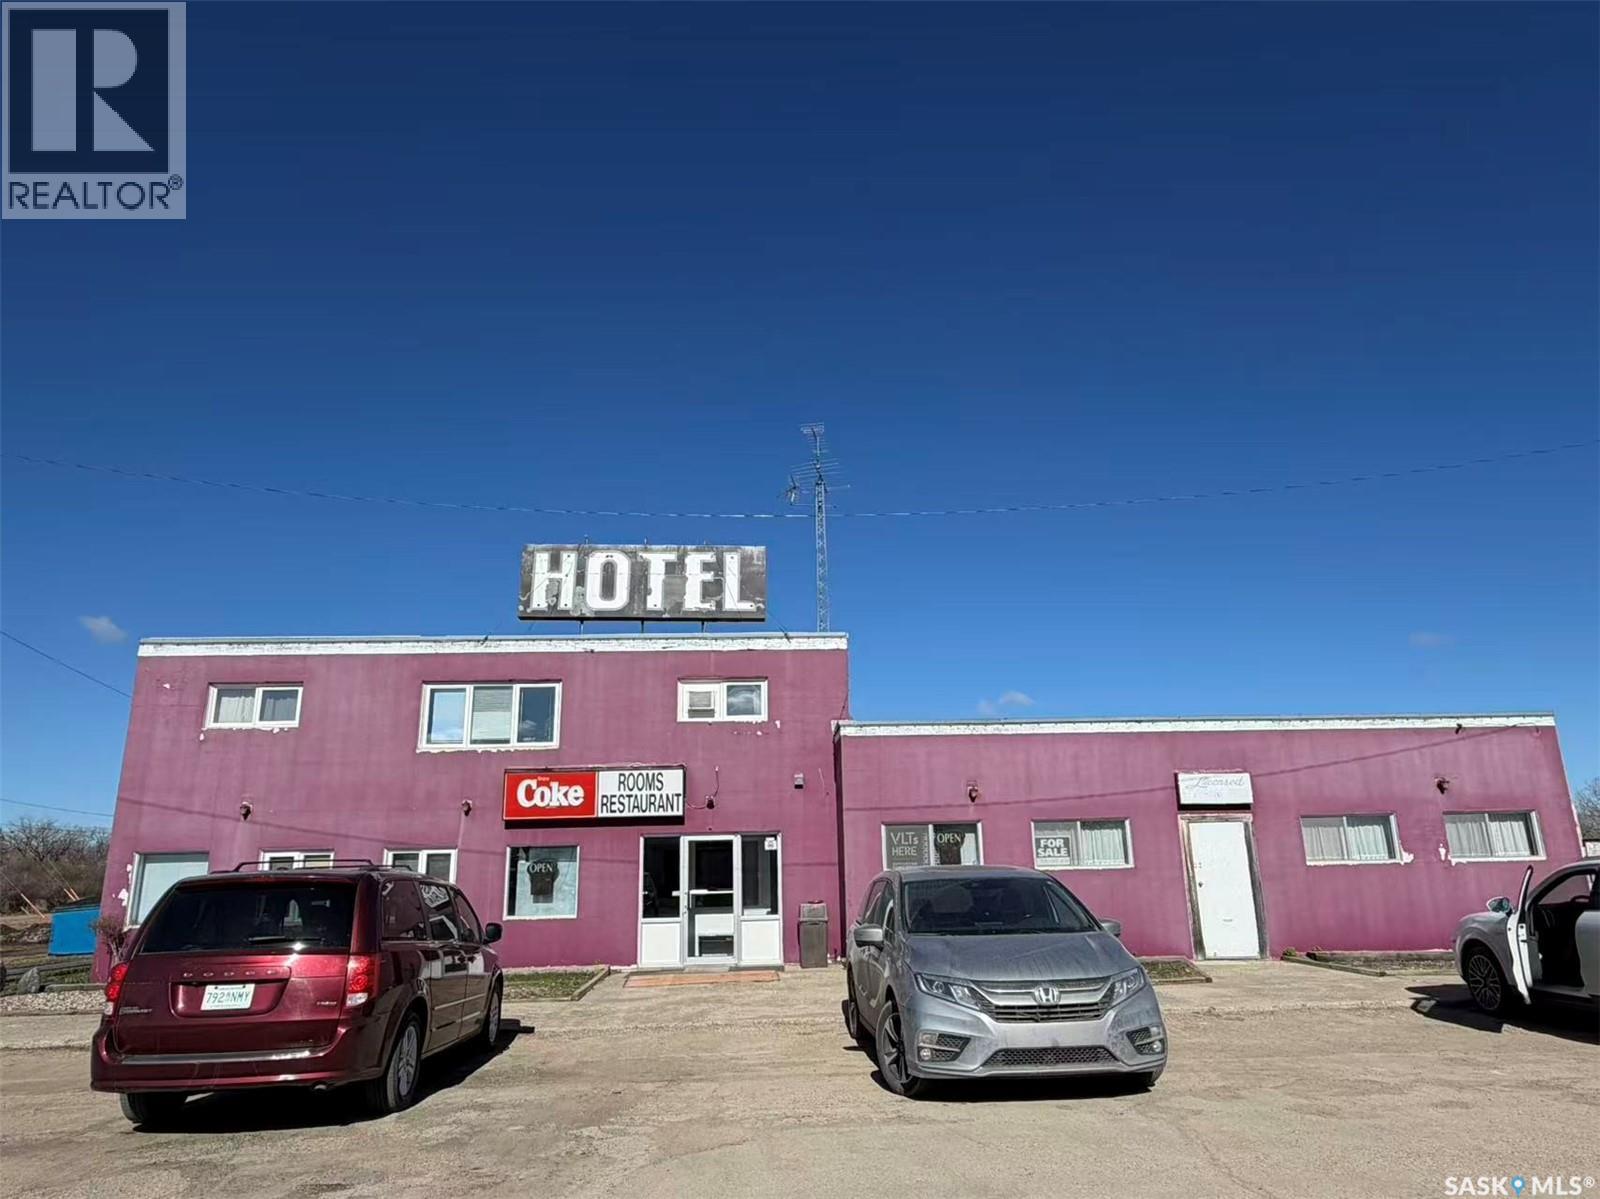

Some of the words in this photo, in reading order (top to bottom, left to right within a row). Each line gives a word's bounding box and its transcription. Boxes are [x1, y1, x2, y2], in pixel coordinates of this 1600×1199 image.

[527, 550, 757, 612] HOTEL
[617, 772, 665, 792] ROOMS
[516, 778, 585, 808] Coke
[600, 793, 682, 814] RESTAURANT
[890, 831, 920, 845] VLTs
[936, 832, 961, 844] OPEN
[1039, 838, 1065, 849] FOR
[890, 845, 918, 857] HERE
[1037, 847, 1069, 858] SALE
[529, 862, 553, 873] OPEN
